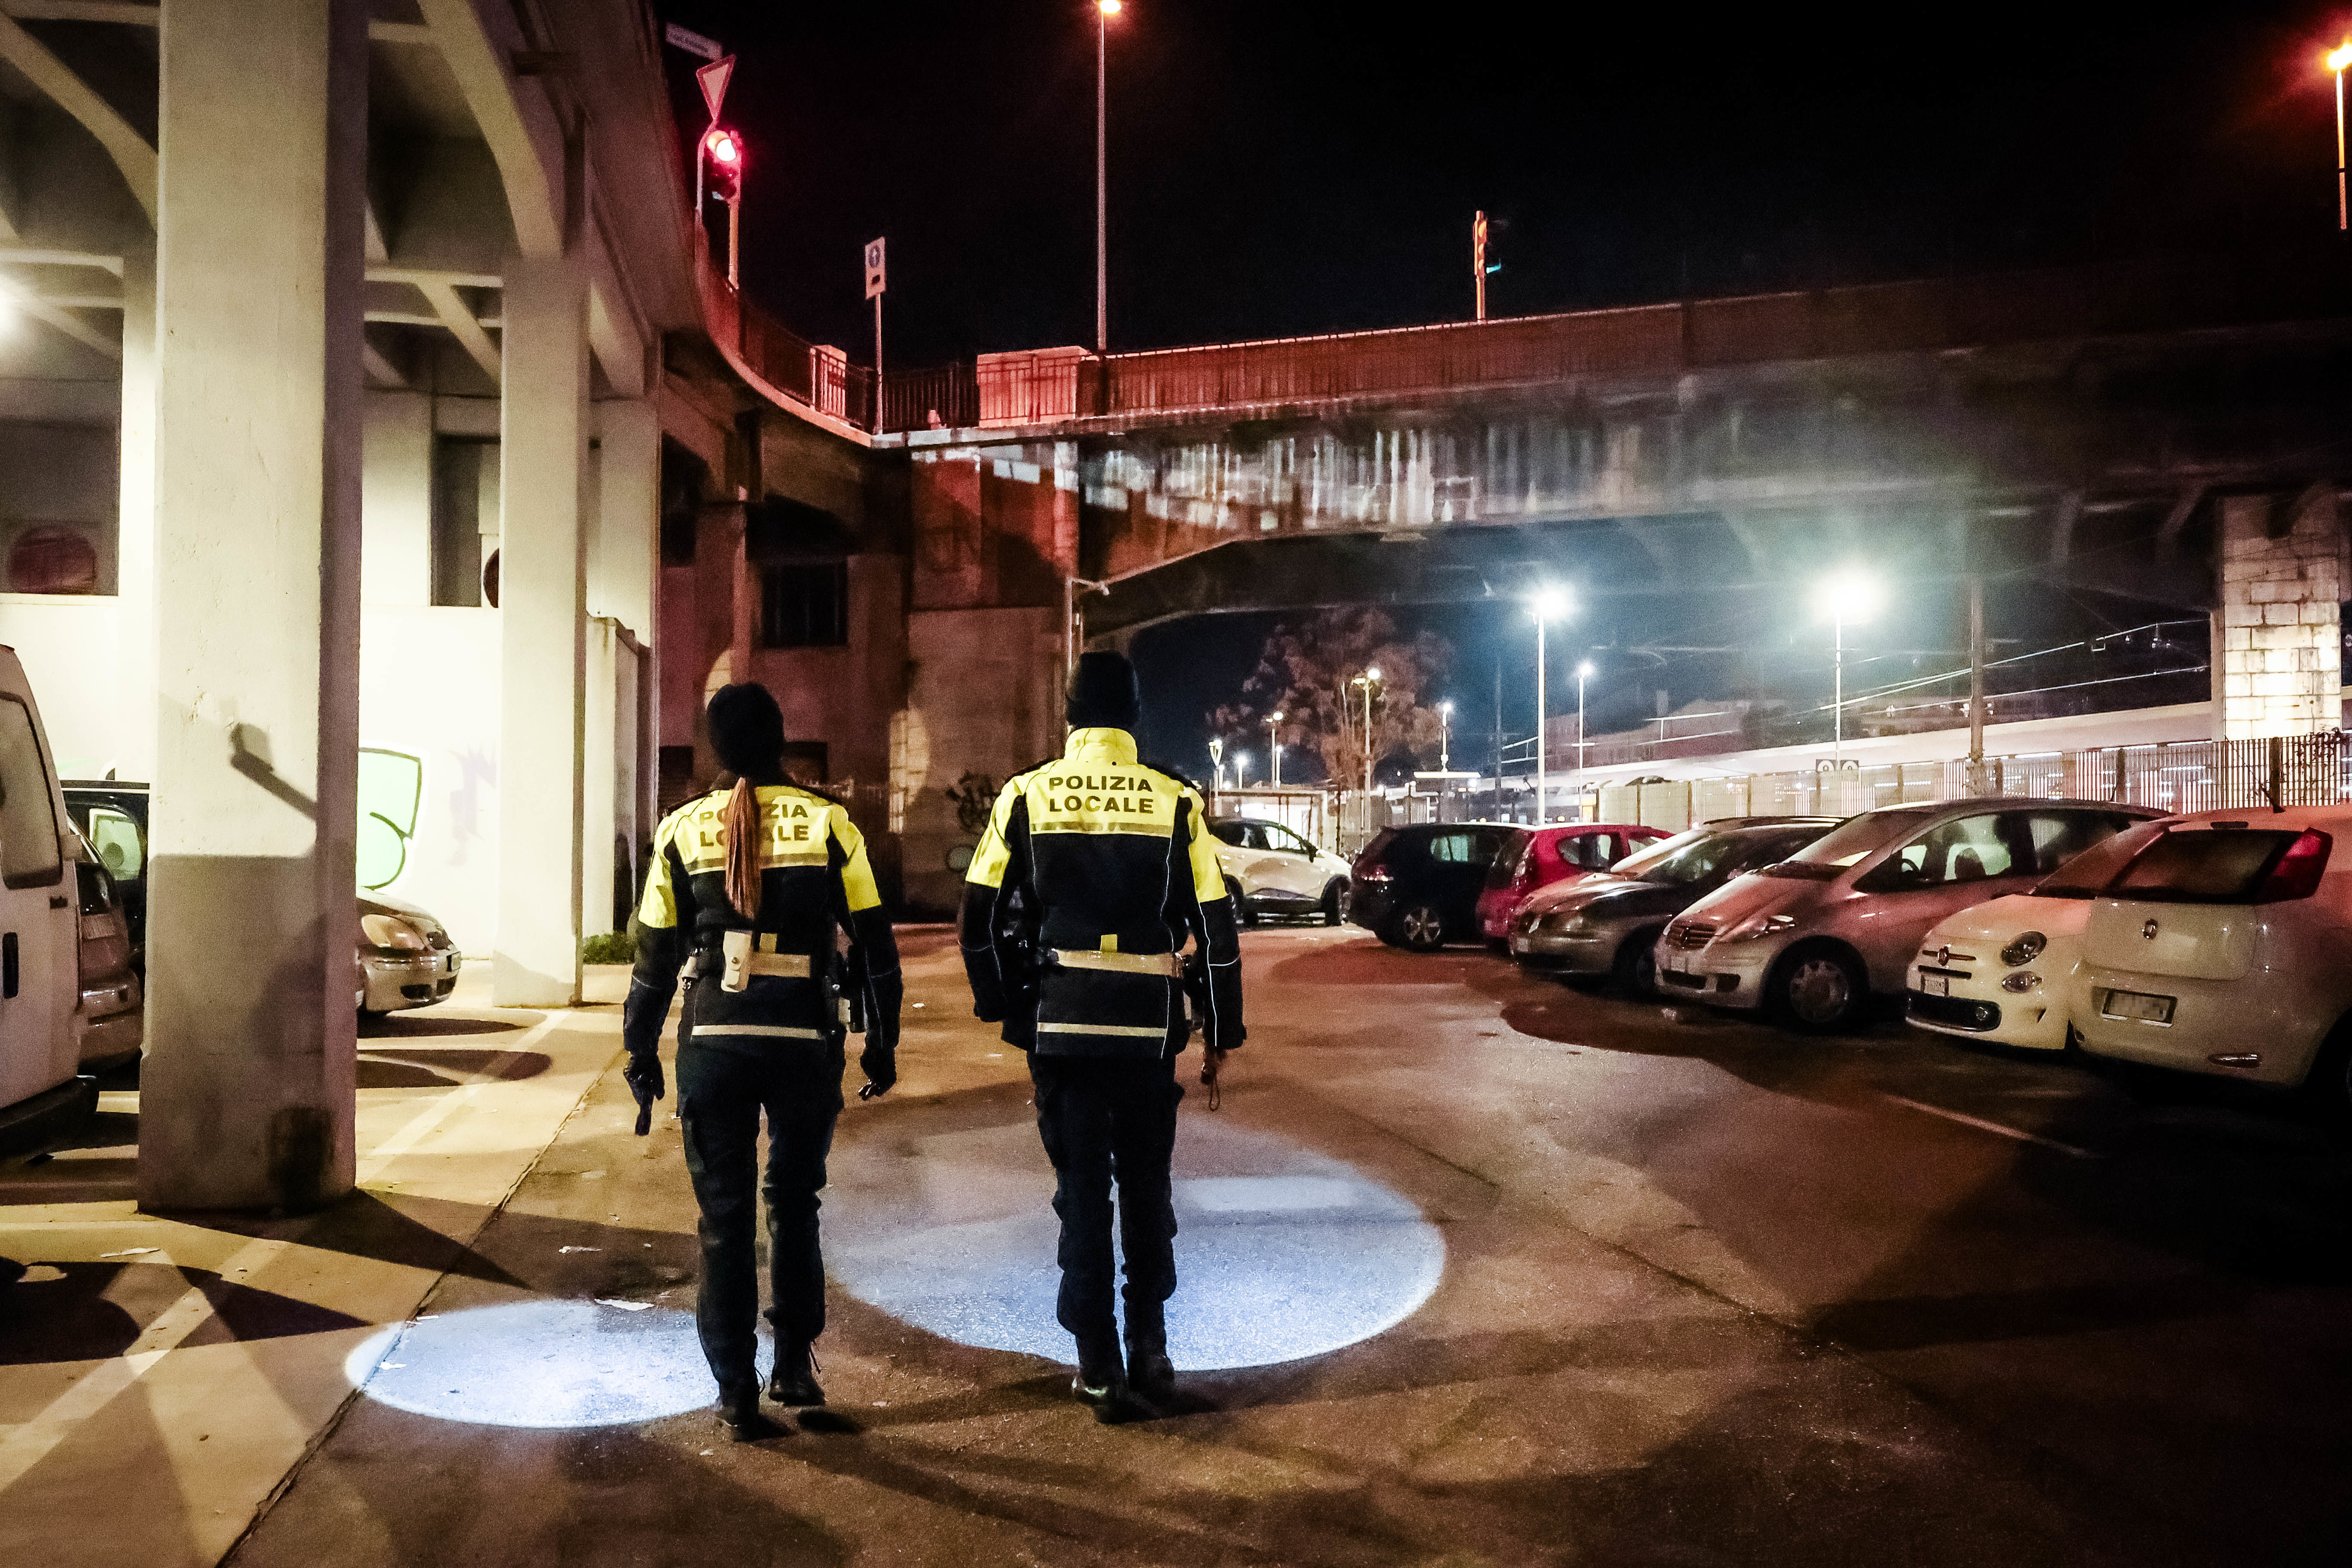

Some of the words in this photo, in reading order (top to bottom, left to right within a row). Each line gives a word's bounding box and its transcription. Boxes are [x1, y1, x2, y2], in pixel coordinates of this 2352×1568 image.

[1049, 775, 1153, 792] POLIZIA
[1049, 796, 1154, 814] LOCALE
[699, 804, 808, 825] POZIA
